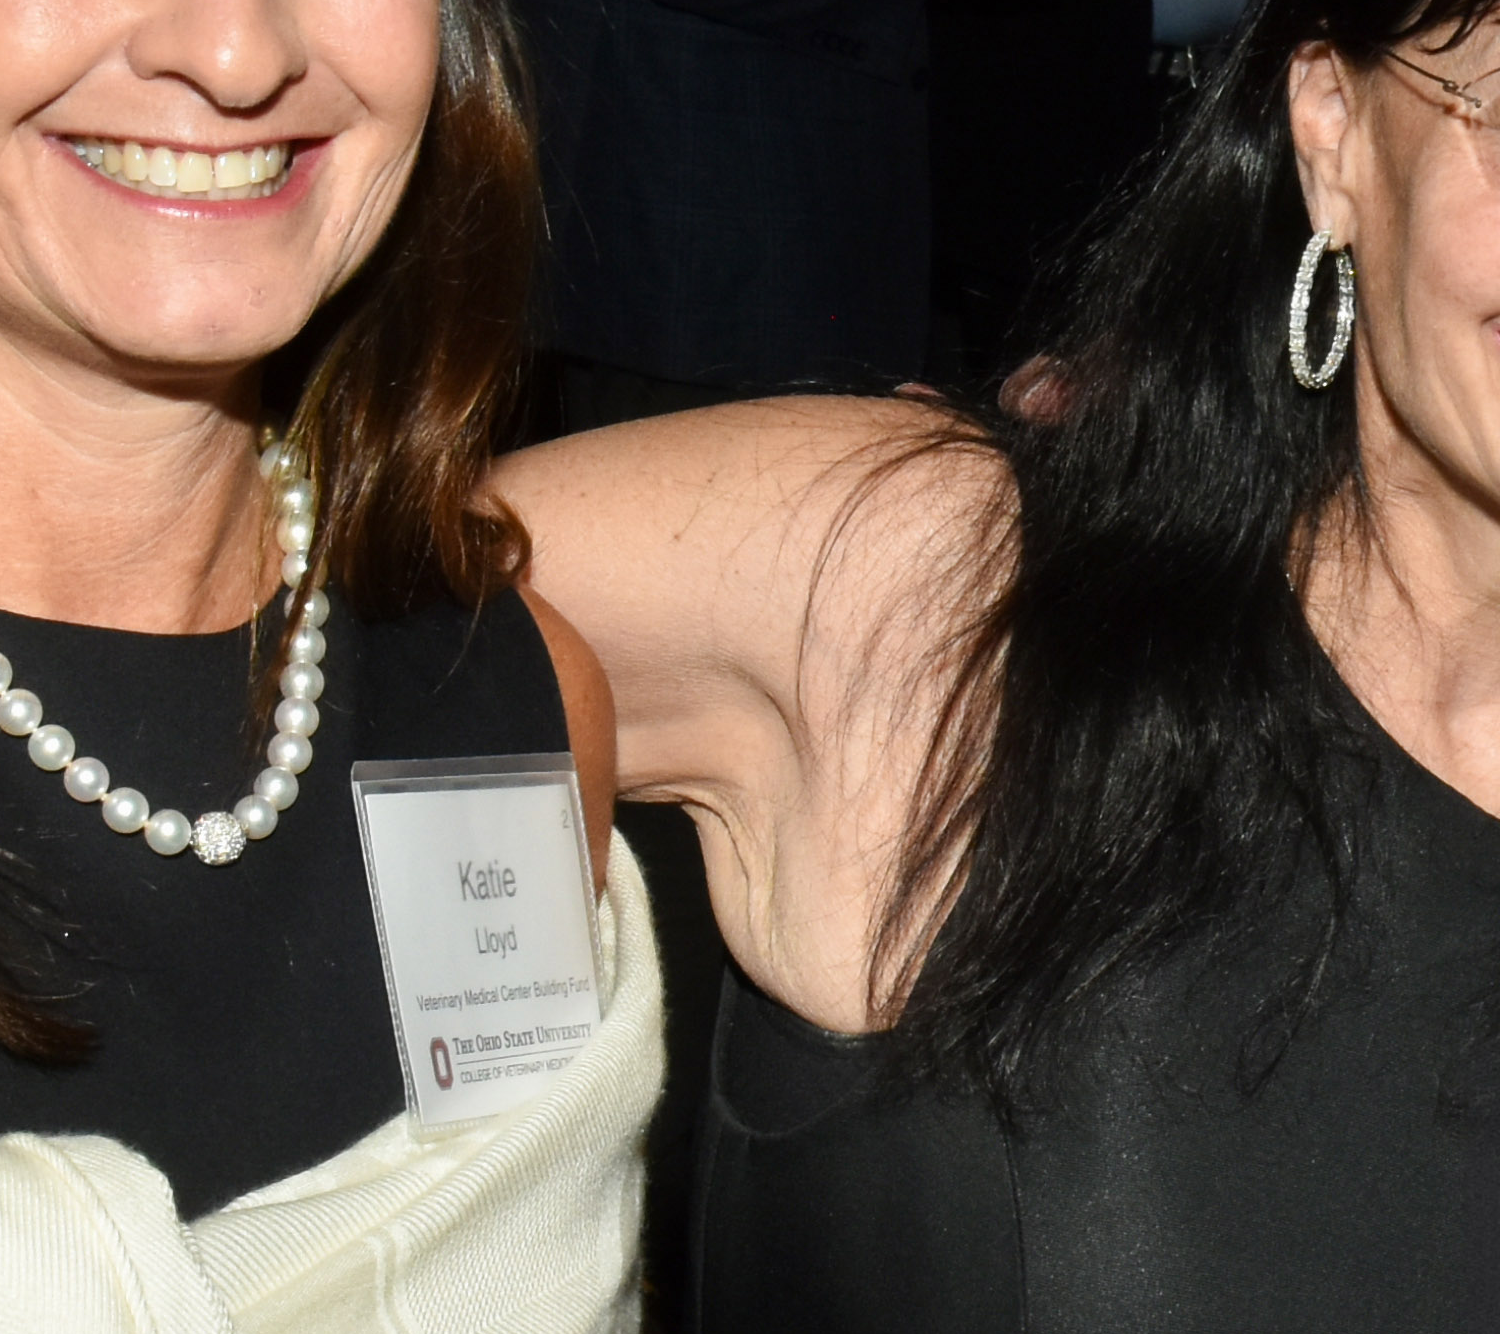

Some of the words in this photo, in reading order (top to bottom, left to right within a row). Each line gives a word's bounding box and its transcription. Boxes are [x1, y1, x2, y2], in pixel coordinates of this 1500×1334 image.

[561, 809, 571, 829] 2
[458, 860, 517, 901] Katie
[475, 927, 518, 959] Lloyd
[416, 994, 463, 1012] Veterinary
[464, 987, 500, 1006] Medical
[501, 985, 532, 1001] Center
[533, 979, 568, 998] Building
[569, 976, 590, 992] Fund
[452, 1037, 475, 1055] THE
[476, 1034, 502, 1052] OHIO
[504, 1030, 534, 1049] STATE
[535, 1023, 591, 1043] UNIVERSITY
[460, 1067, 492, 1084] COLLEGE
[492, 1065, 503, 1079] OF
[504, 1061, 545, 1078] VETERINARY
